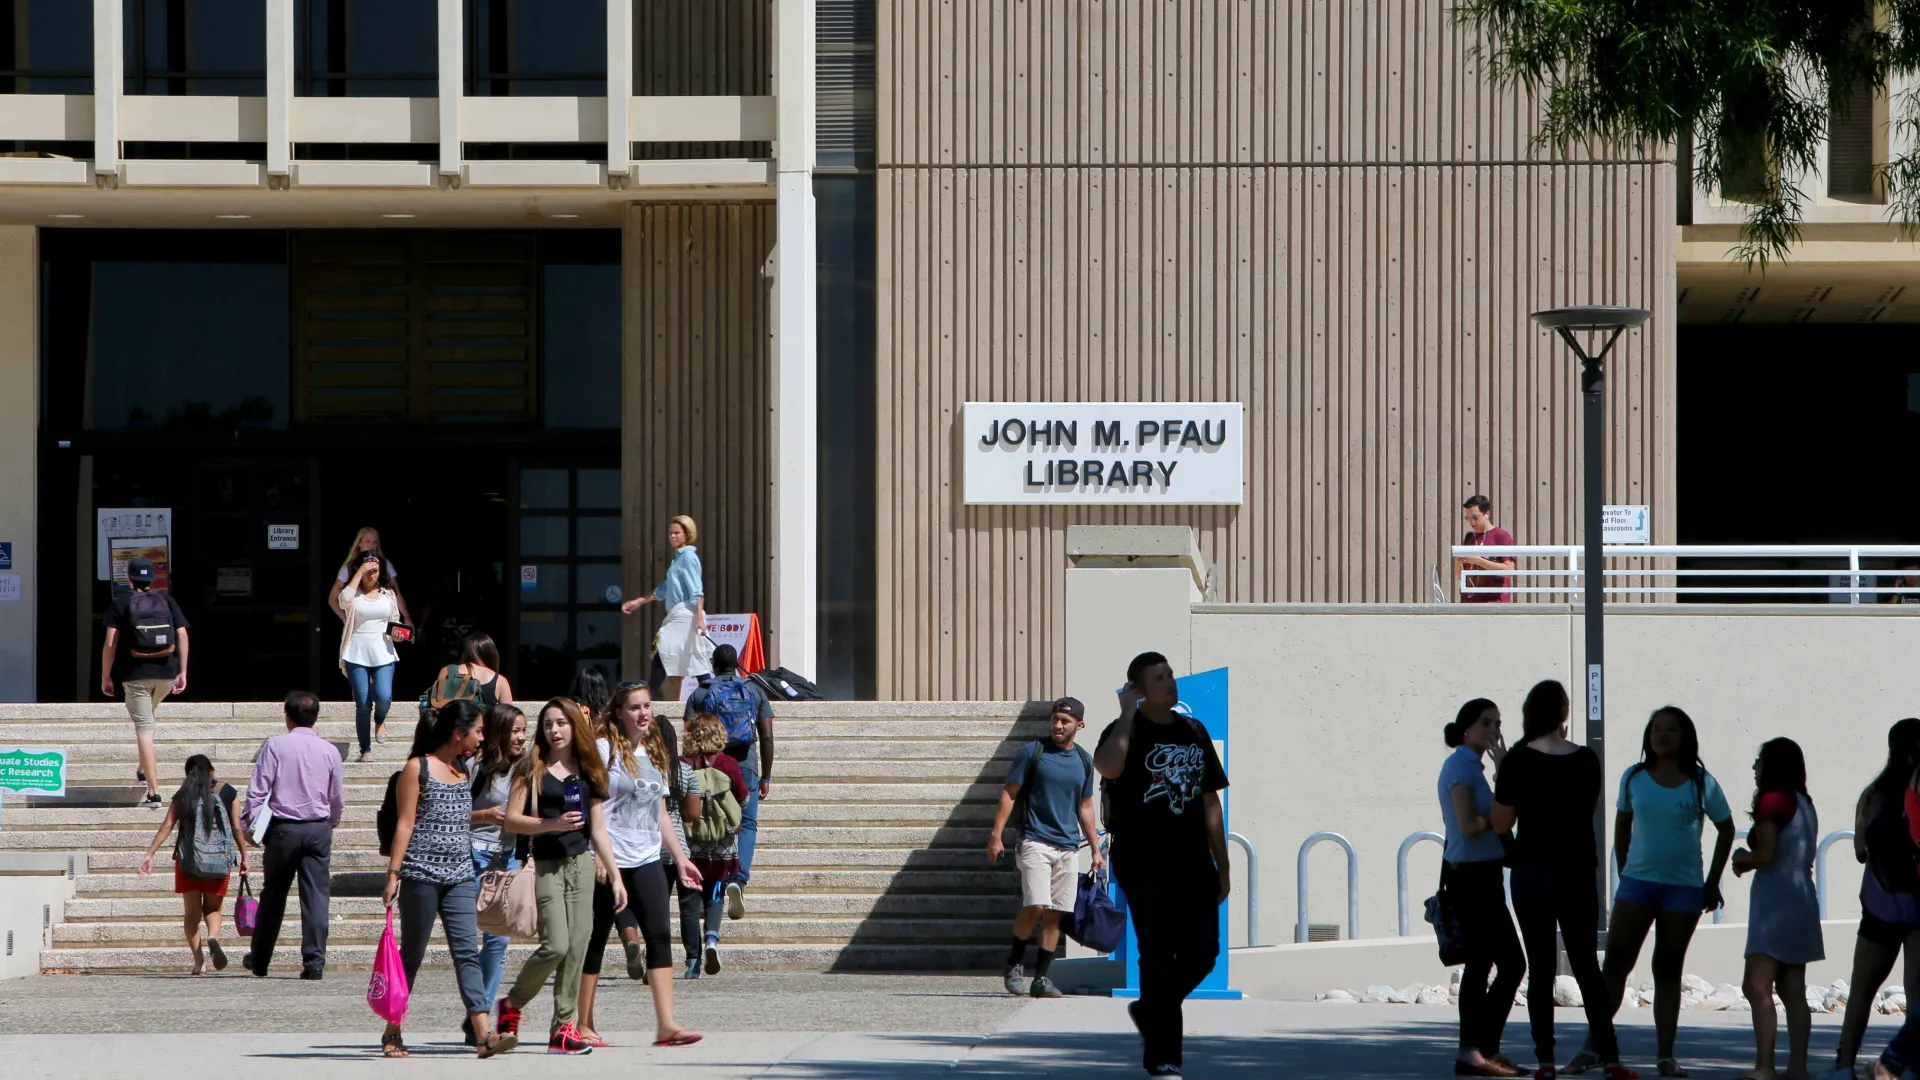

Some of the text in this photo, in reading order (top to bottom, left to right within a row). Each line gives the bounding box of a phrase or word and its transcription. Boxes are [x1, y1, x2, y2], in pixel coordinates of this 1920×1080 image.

[981, 418, 1226, 446] JOHN M. PFAU
[1027, 460, 1178, 487] LIBRARY
[273, 527, 295, 535] Library
[23, 757, 60, 767] Studies
[1145, 743, 1205, 771] Cali
[8, 767, 54, 778] Research
